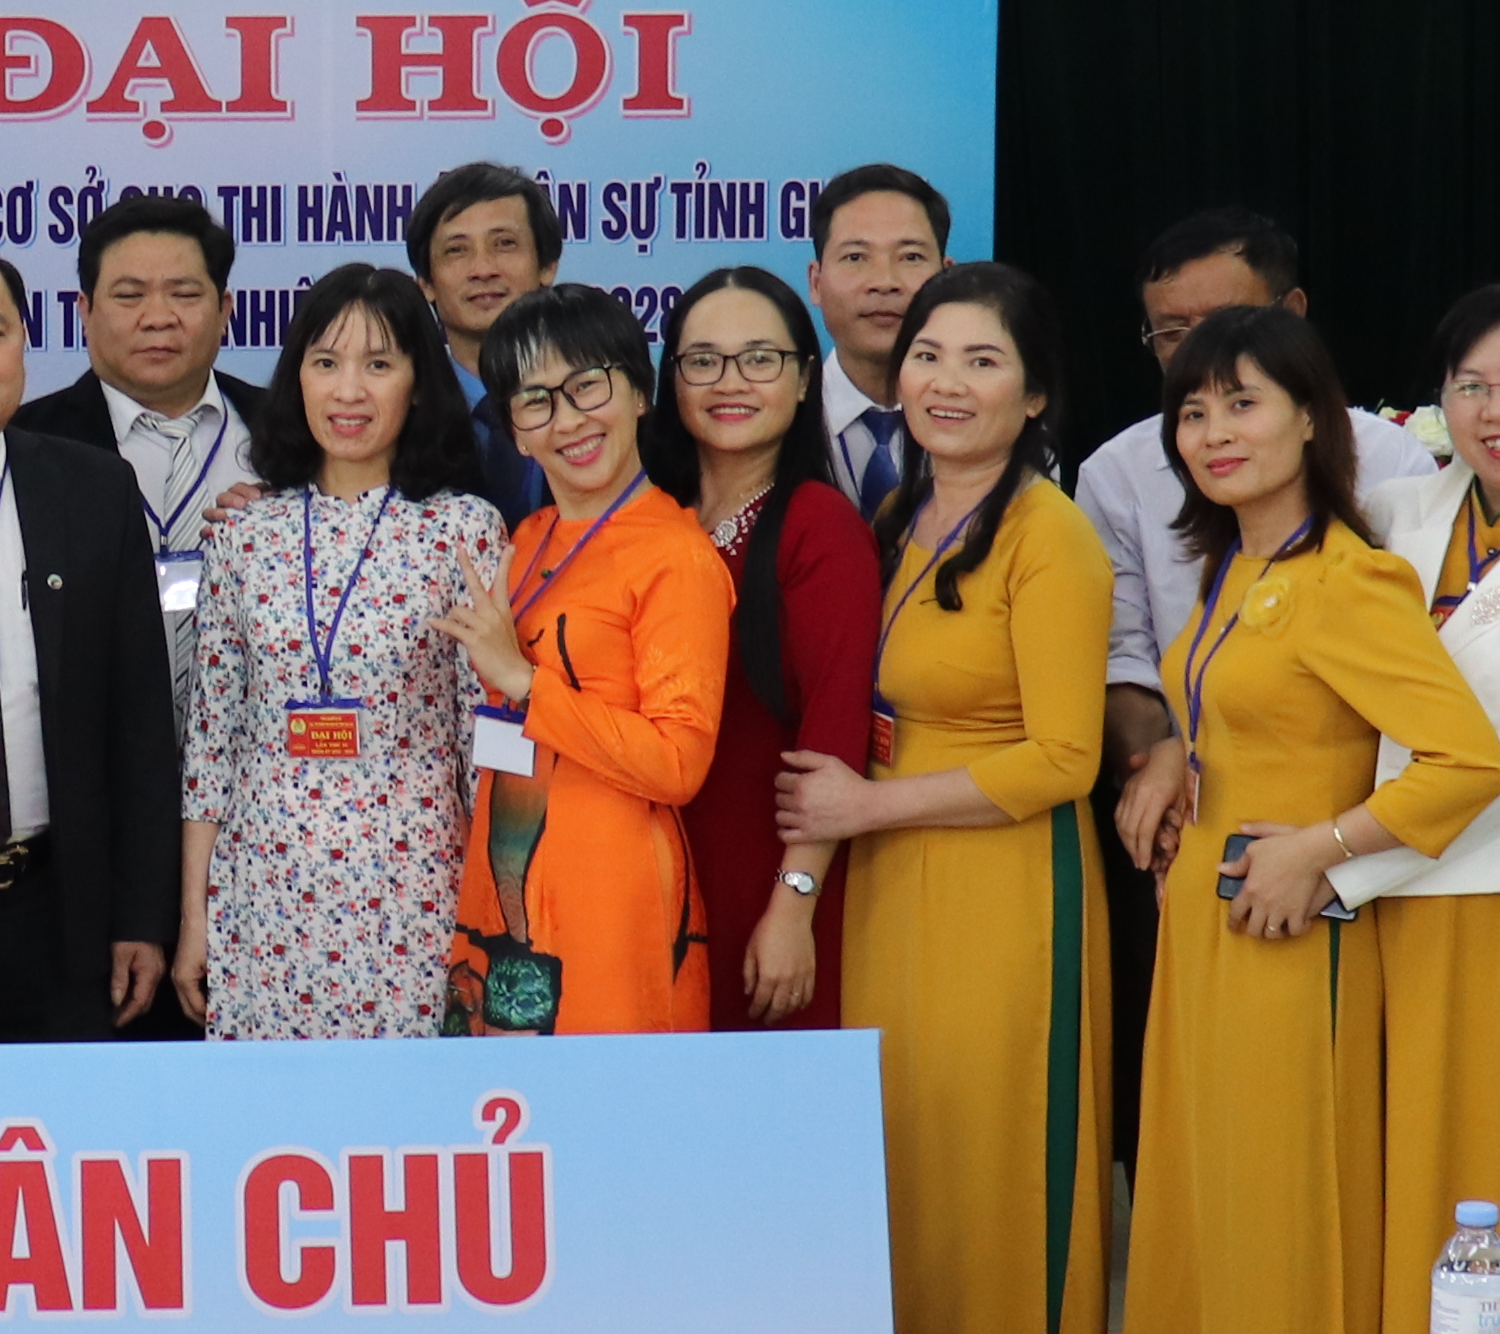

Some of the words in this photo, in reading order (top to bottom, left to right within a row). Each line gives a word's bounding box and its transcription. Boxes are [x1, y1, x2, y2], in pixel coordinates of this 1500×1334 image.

[48, 165, 106, 244] SỞ
[217, 185, 284, 244] THI
[296, 171, 413, 244] HÀNH
[601, 176, 665, 254] SỰ
[670, 161, 766, 243] TỈNH
[244, 1096, 548, 1310] CHỦ
